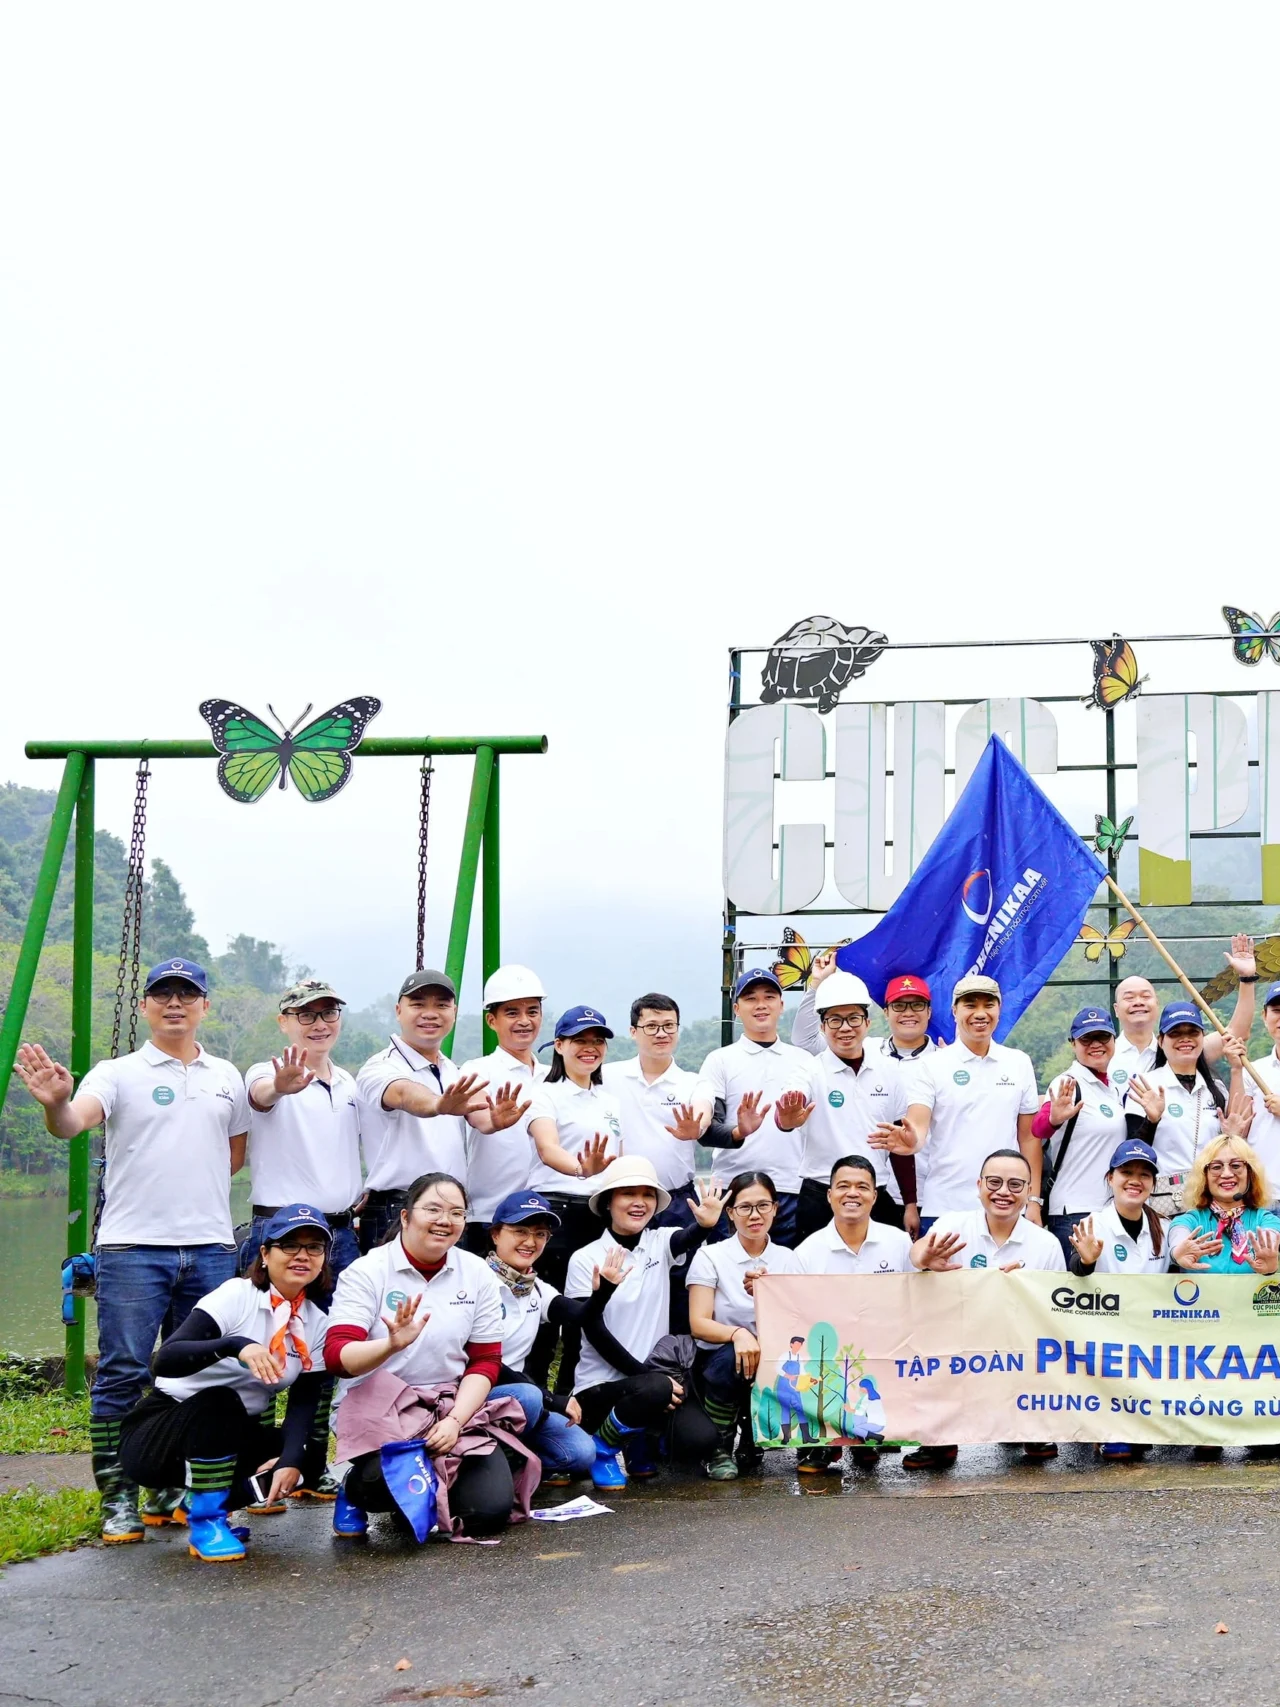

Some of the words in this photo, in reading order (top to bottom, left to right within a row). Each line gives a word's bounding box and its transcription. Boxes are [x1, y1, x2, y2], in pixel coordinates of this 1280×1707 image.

[1051, 1287, 1120, 1311] Gaia
[1051, 1307, 1074, 1315] NATURE
[1152, 1309, 1220, 1319] PHENIKAA
[894, 1355, 941, 1382] TẬP
[948, 1350, 1024, 1375] ĐOÀN
[1016, 1394, 1101, 1412] CHUNG
[1110, 1394, 1152, 1416] SỨC
[1160, 1392, 1244, 1418] TRỒNG
